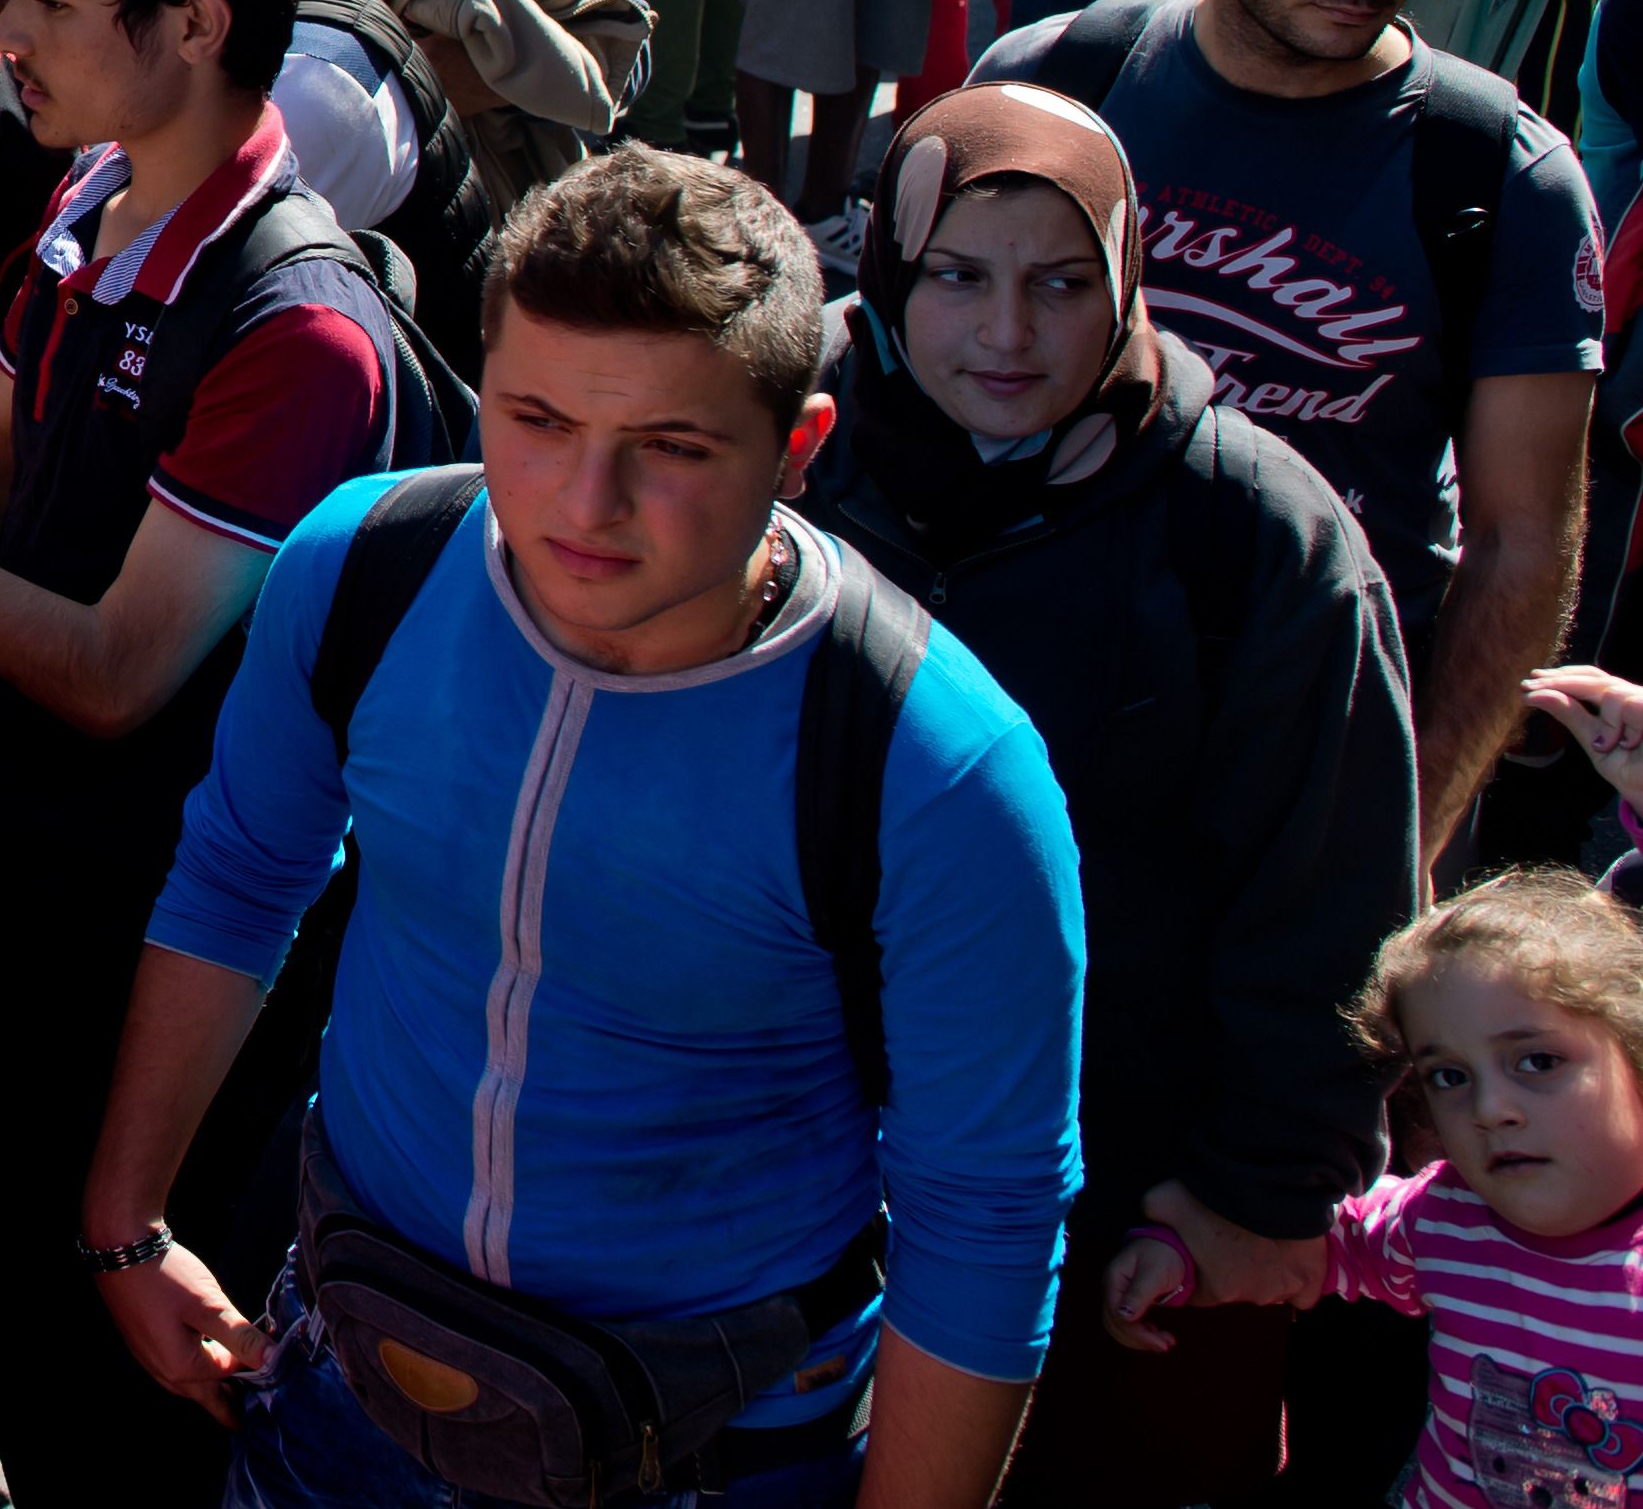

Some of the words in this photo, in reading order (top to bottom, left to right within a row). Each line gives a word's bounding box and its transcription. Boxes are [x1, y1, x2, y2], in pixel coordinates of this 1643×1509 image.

[1139, 203, 1424, 364] rshall
[119, 350, 146, 376] 83
[1193, 340, 1396, 424] Trend
